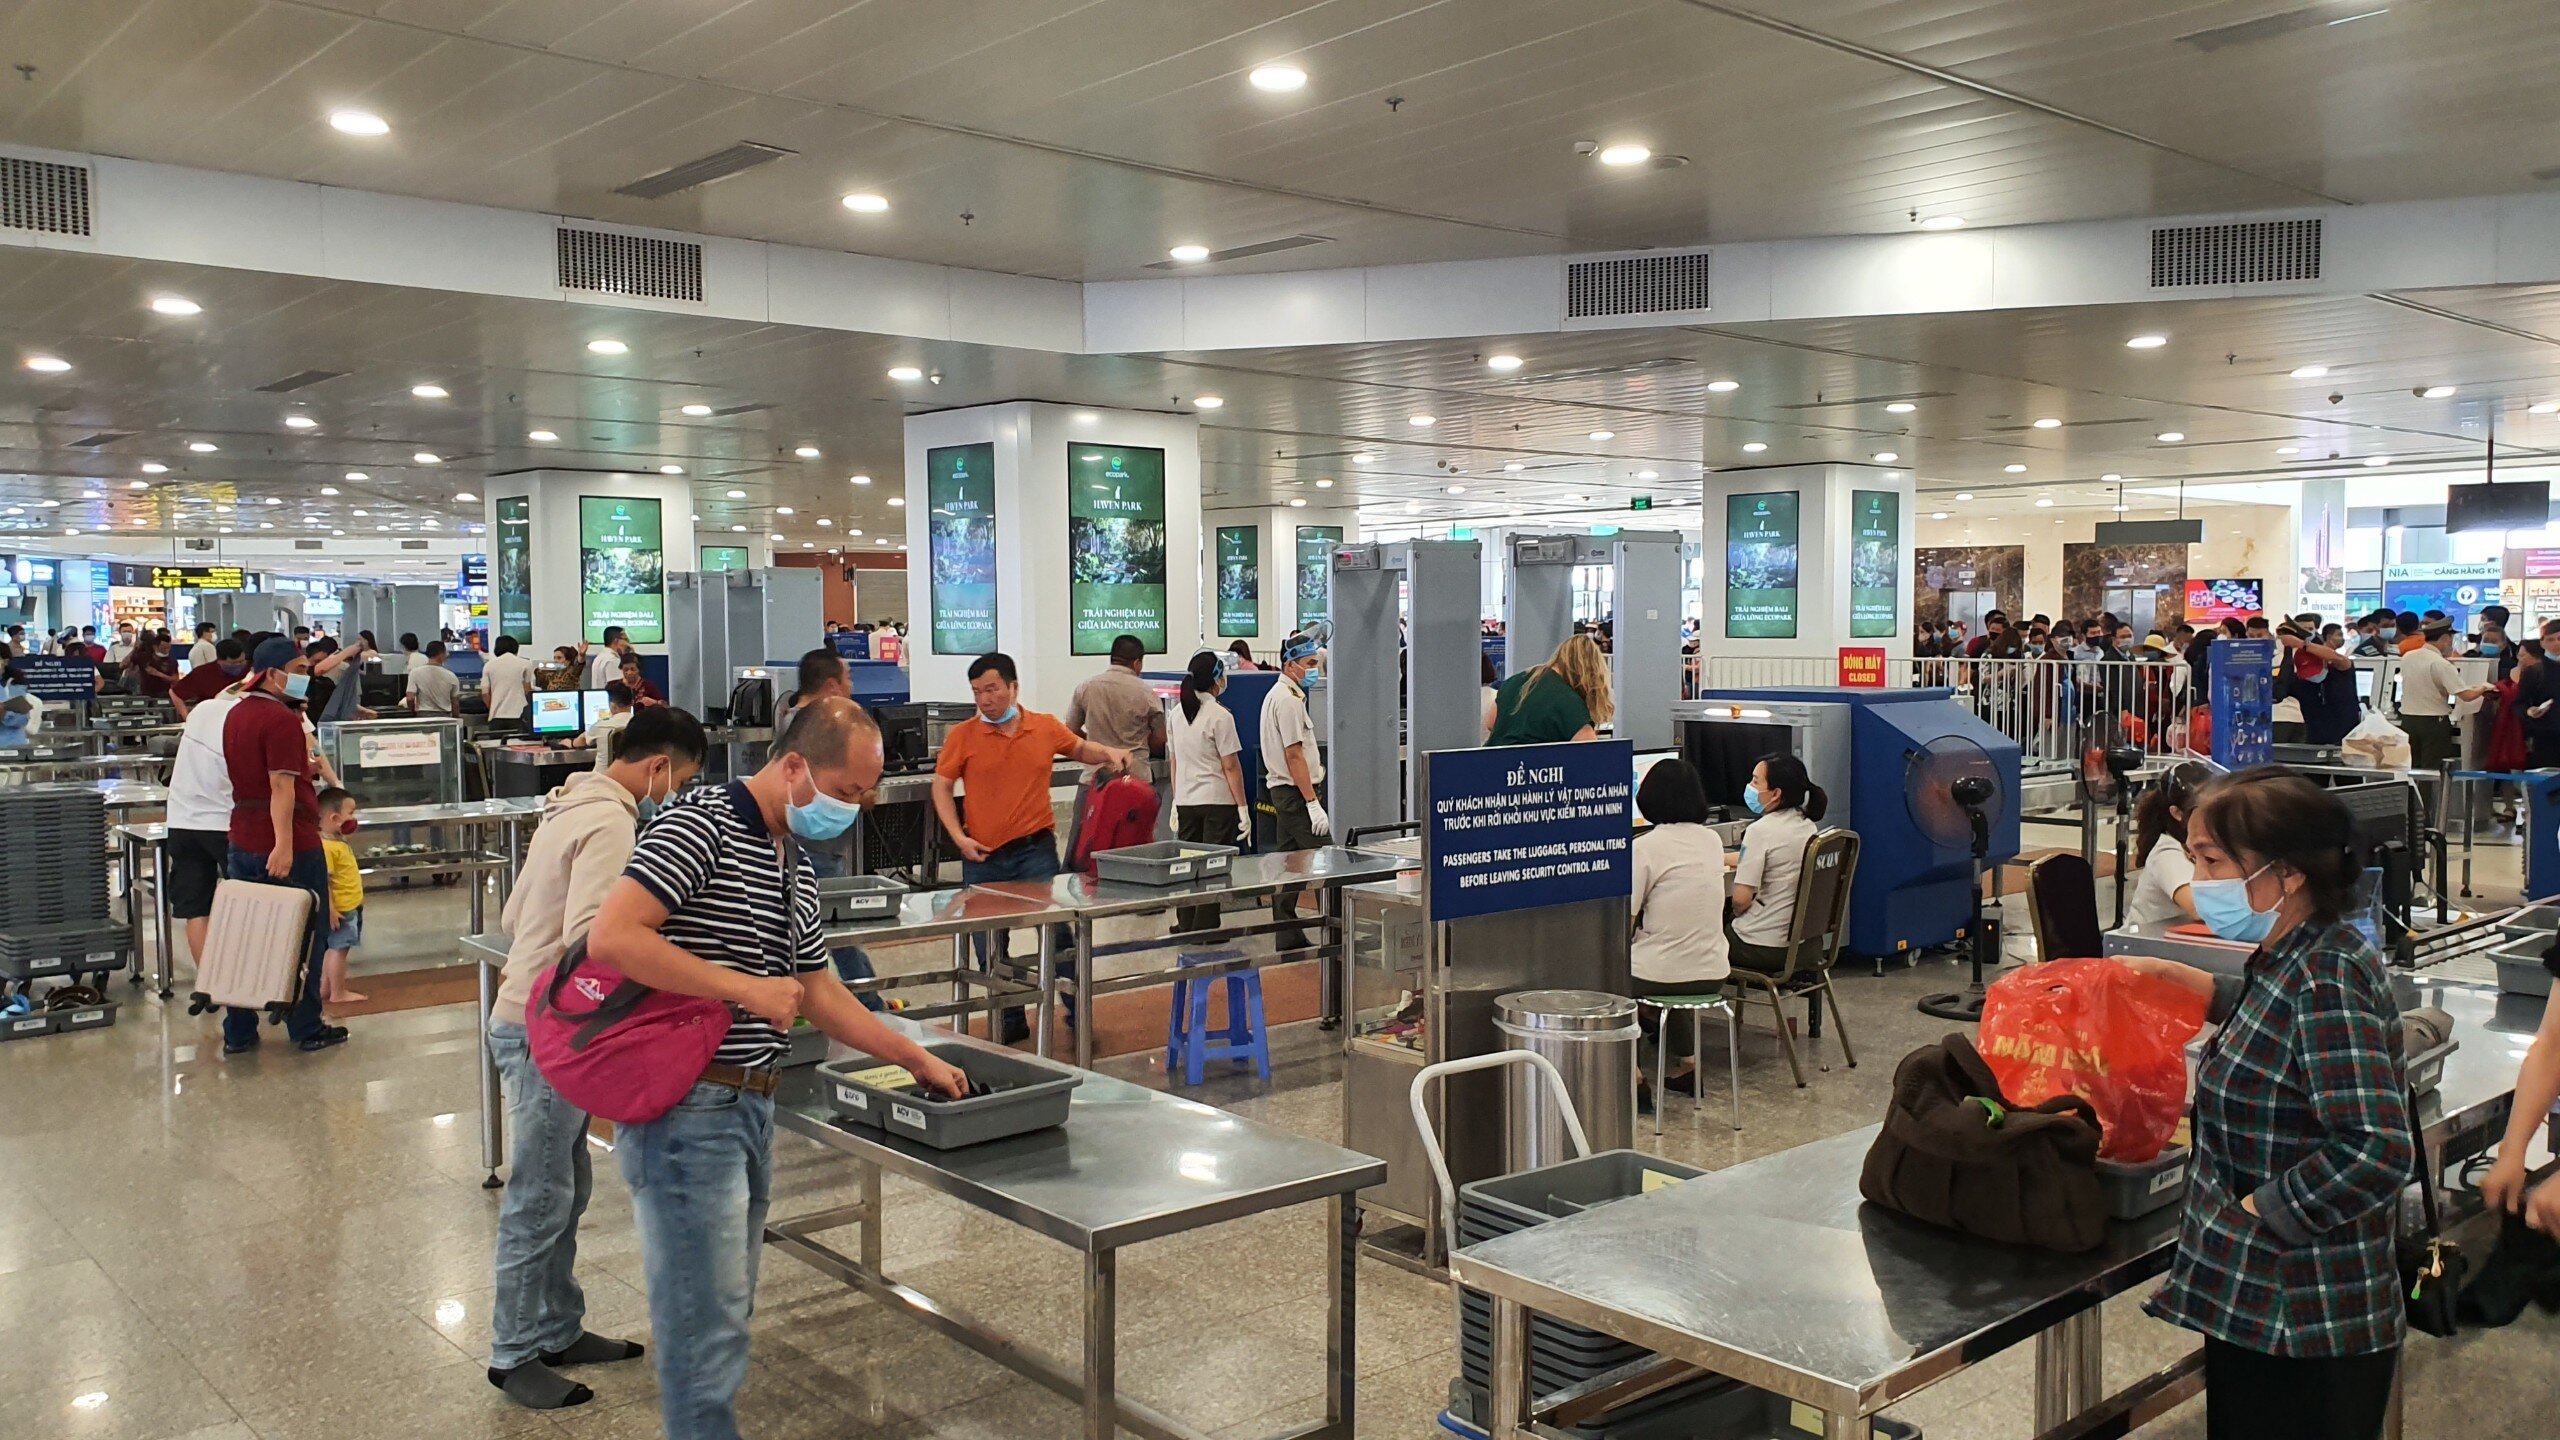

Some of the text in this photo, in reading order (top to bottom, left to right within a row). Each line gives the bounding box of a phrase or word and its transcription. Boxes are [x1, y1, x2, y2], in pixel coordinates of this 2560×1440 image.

[1093, 499, 1142, 511] HAVEN PARK
[2388, 567, 2410, 578] NIA
[1105, 608, 1136, 619] NGHIỆM
[1138, 609, 1155, 618] BALI
[1125, 621, 1160, 630] ECOPARK
[1849, 672, 1876, 682] CLOSED
[1507, 761, 1564, 787] ĐỀ NGHỊ
[1437, 782, 1629, 814] QUÝ KHÁCH NHẬN LẠI HÀNH LÝ VẬT DỤNG CÁ NHÂN
[1444, 813, 1471, 831] TRƯỚC
[1473, 815, 1486, 828] KHI
[1523, 810, 1539, 823] KHU
[1540, 807, 1556, 823] VỰC
[1577, 805, 1592, 817] TRA
[1593, 804, 1604, 816] AN
[1605, 803, 1622, 815] NINH
[1443, 838, 1626, 868] PASSENGERS TAKE THE LUGGAGES, PERSONAL ITEMS
[1459, 859, 1610, 888] BEFORE LEAVING SECURITY CONTROL AREA
